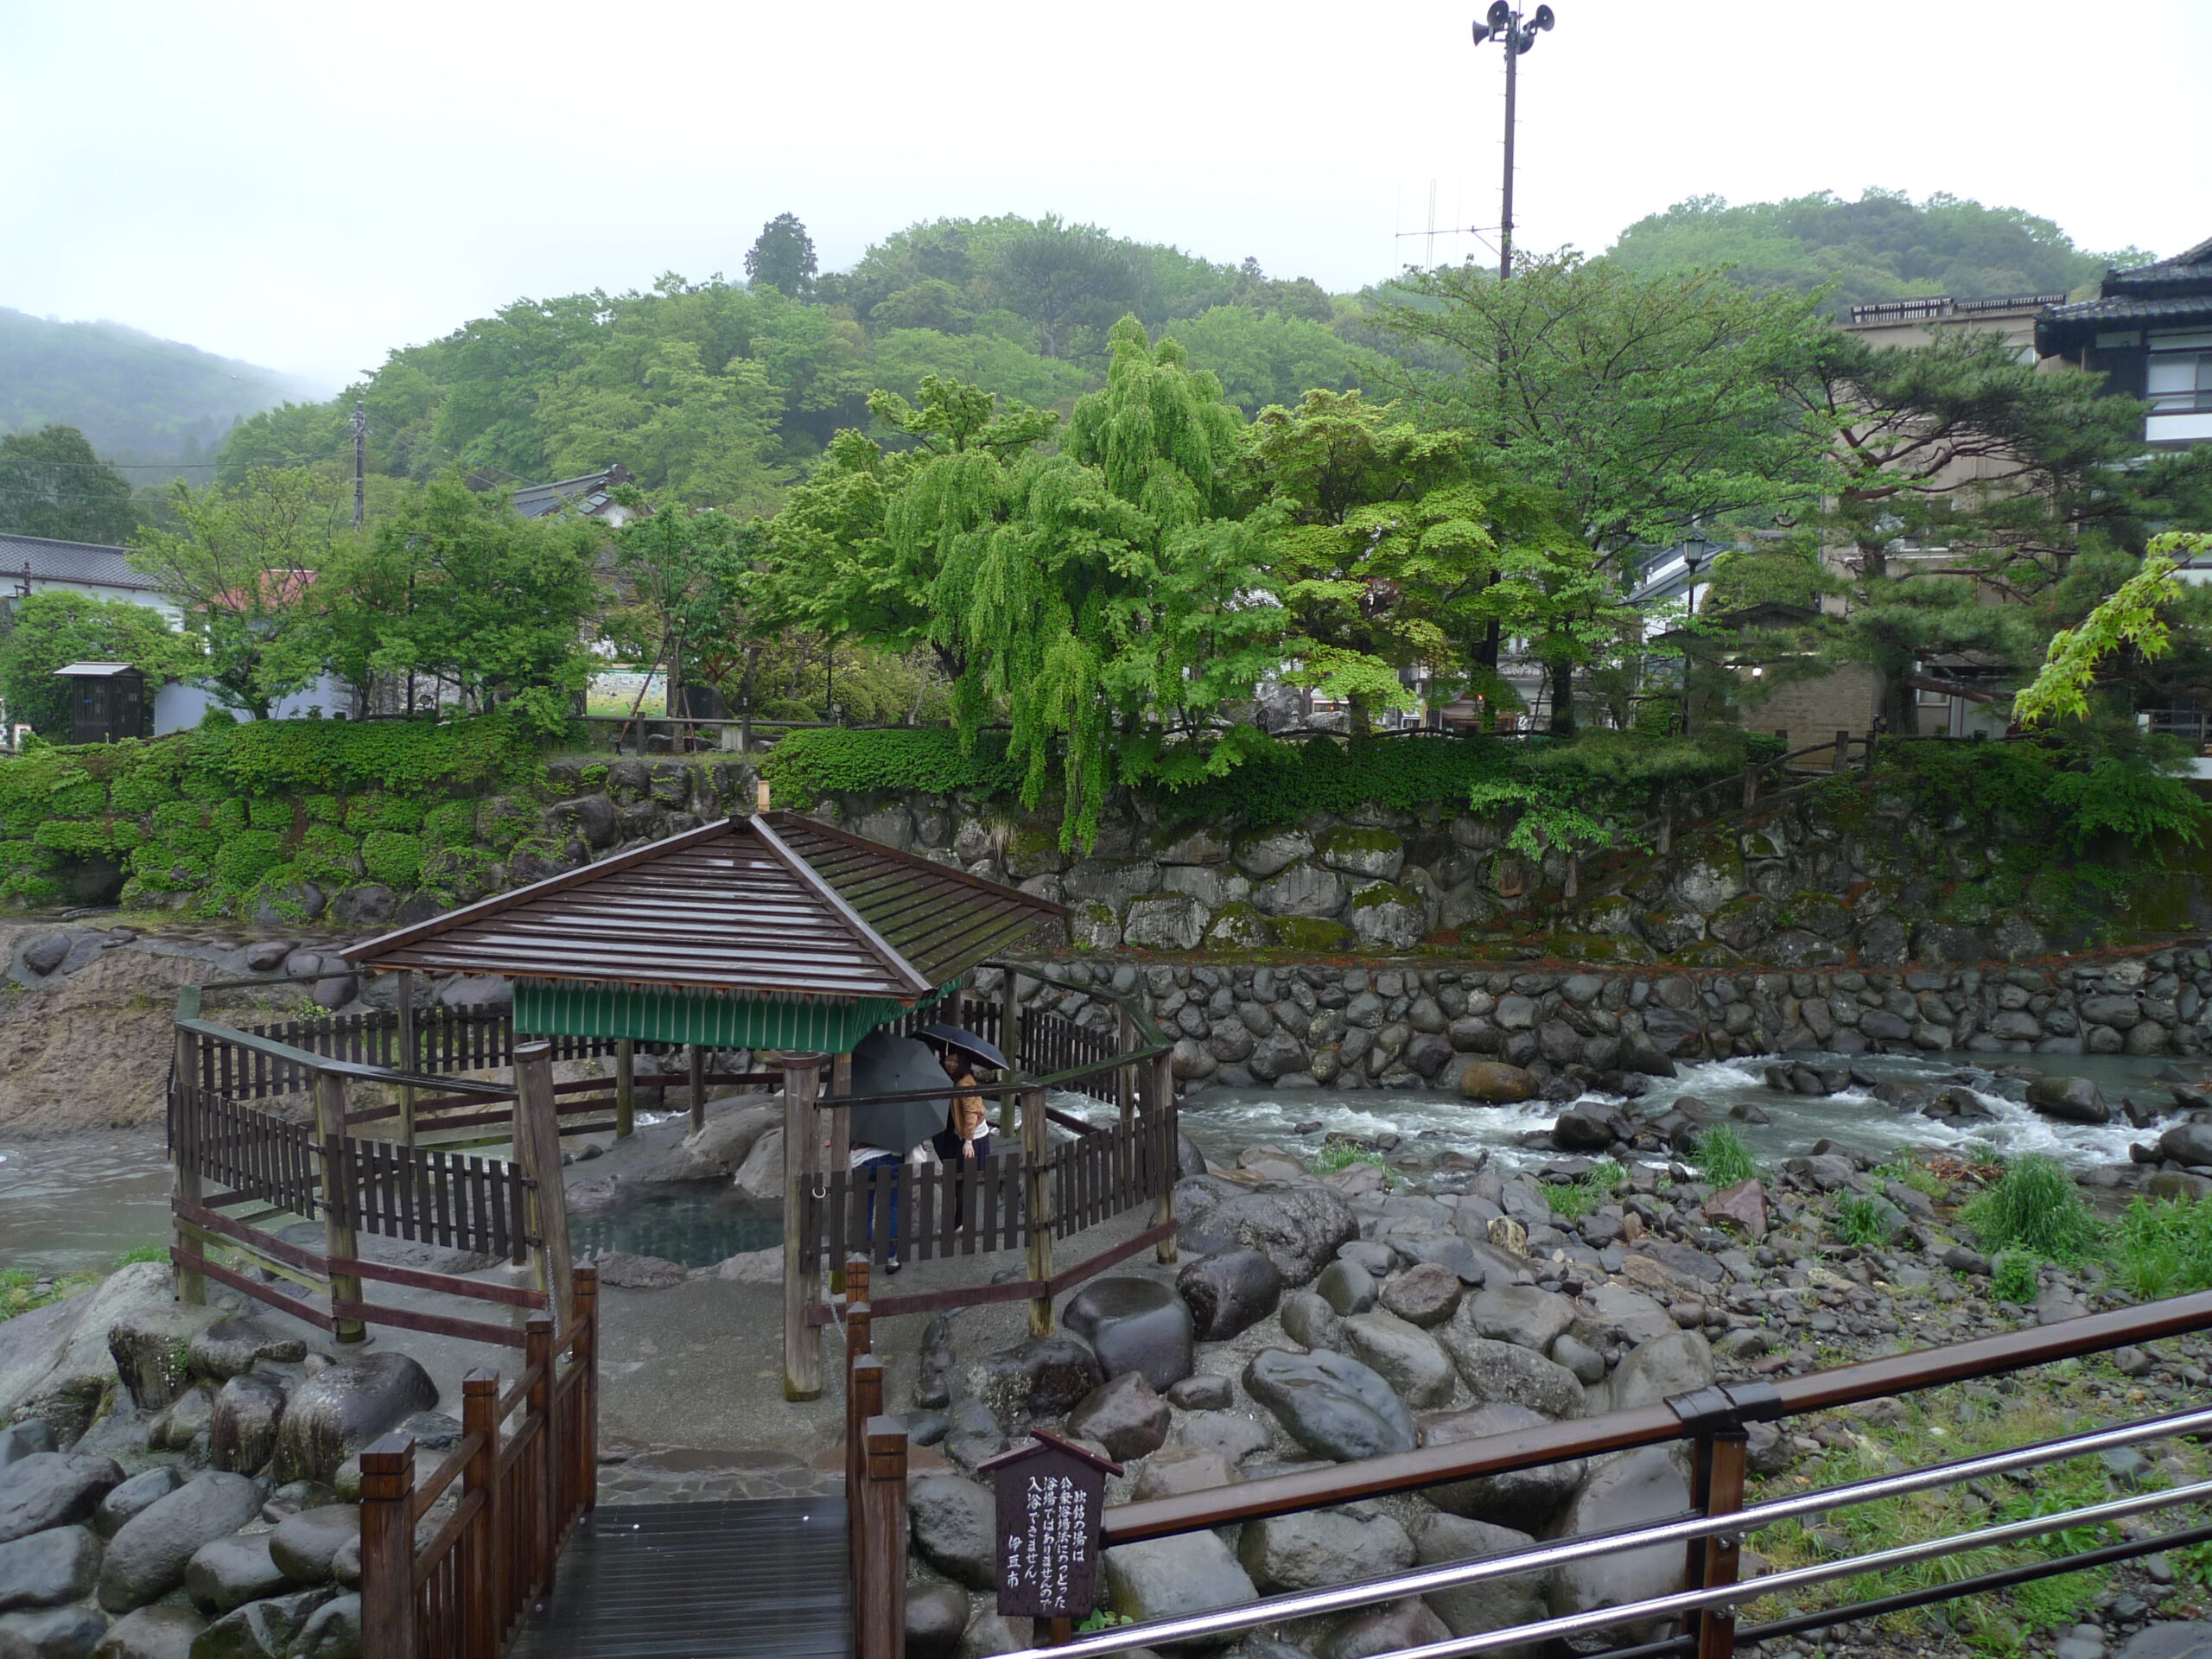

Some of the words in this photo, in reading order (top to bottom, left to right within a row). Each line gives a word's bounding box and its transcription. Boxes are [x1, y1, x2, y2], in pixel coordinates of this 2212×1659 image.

[1007, 1535, 1022, 1588] 伊豆市
[1039, 1476, 1058, 1611] 浴場ではありませんので
